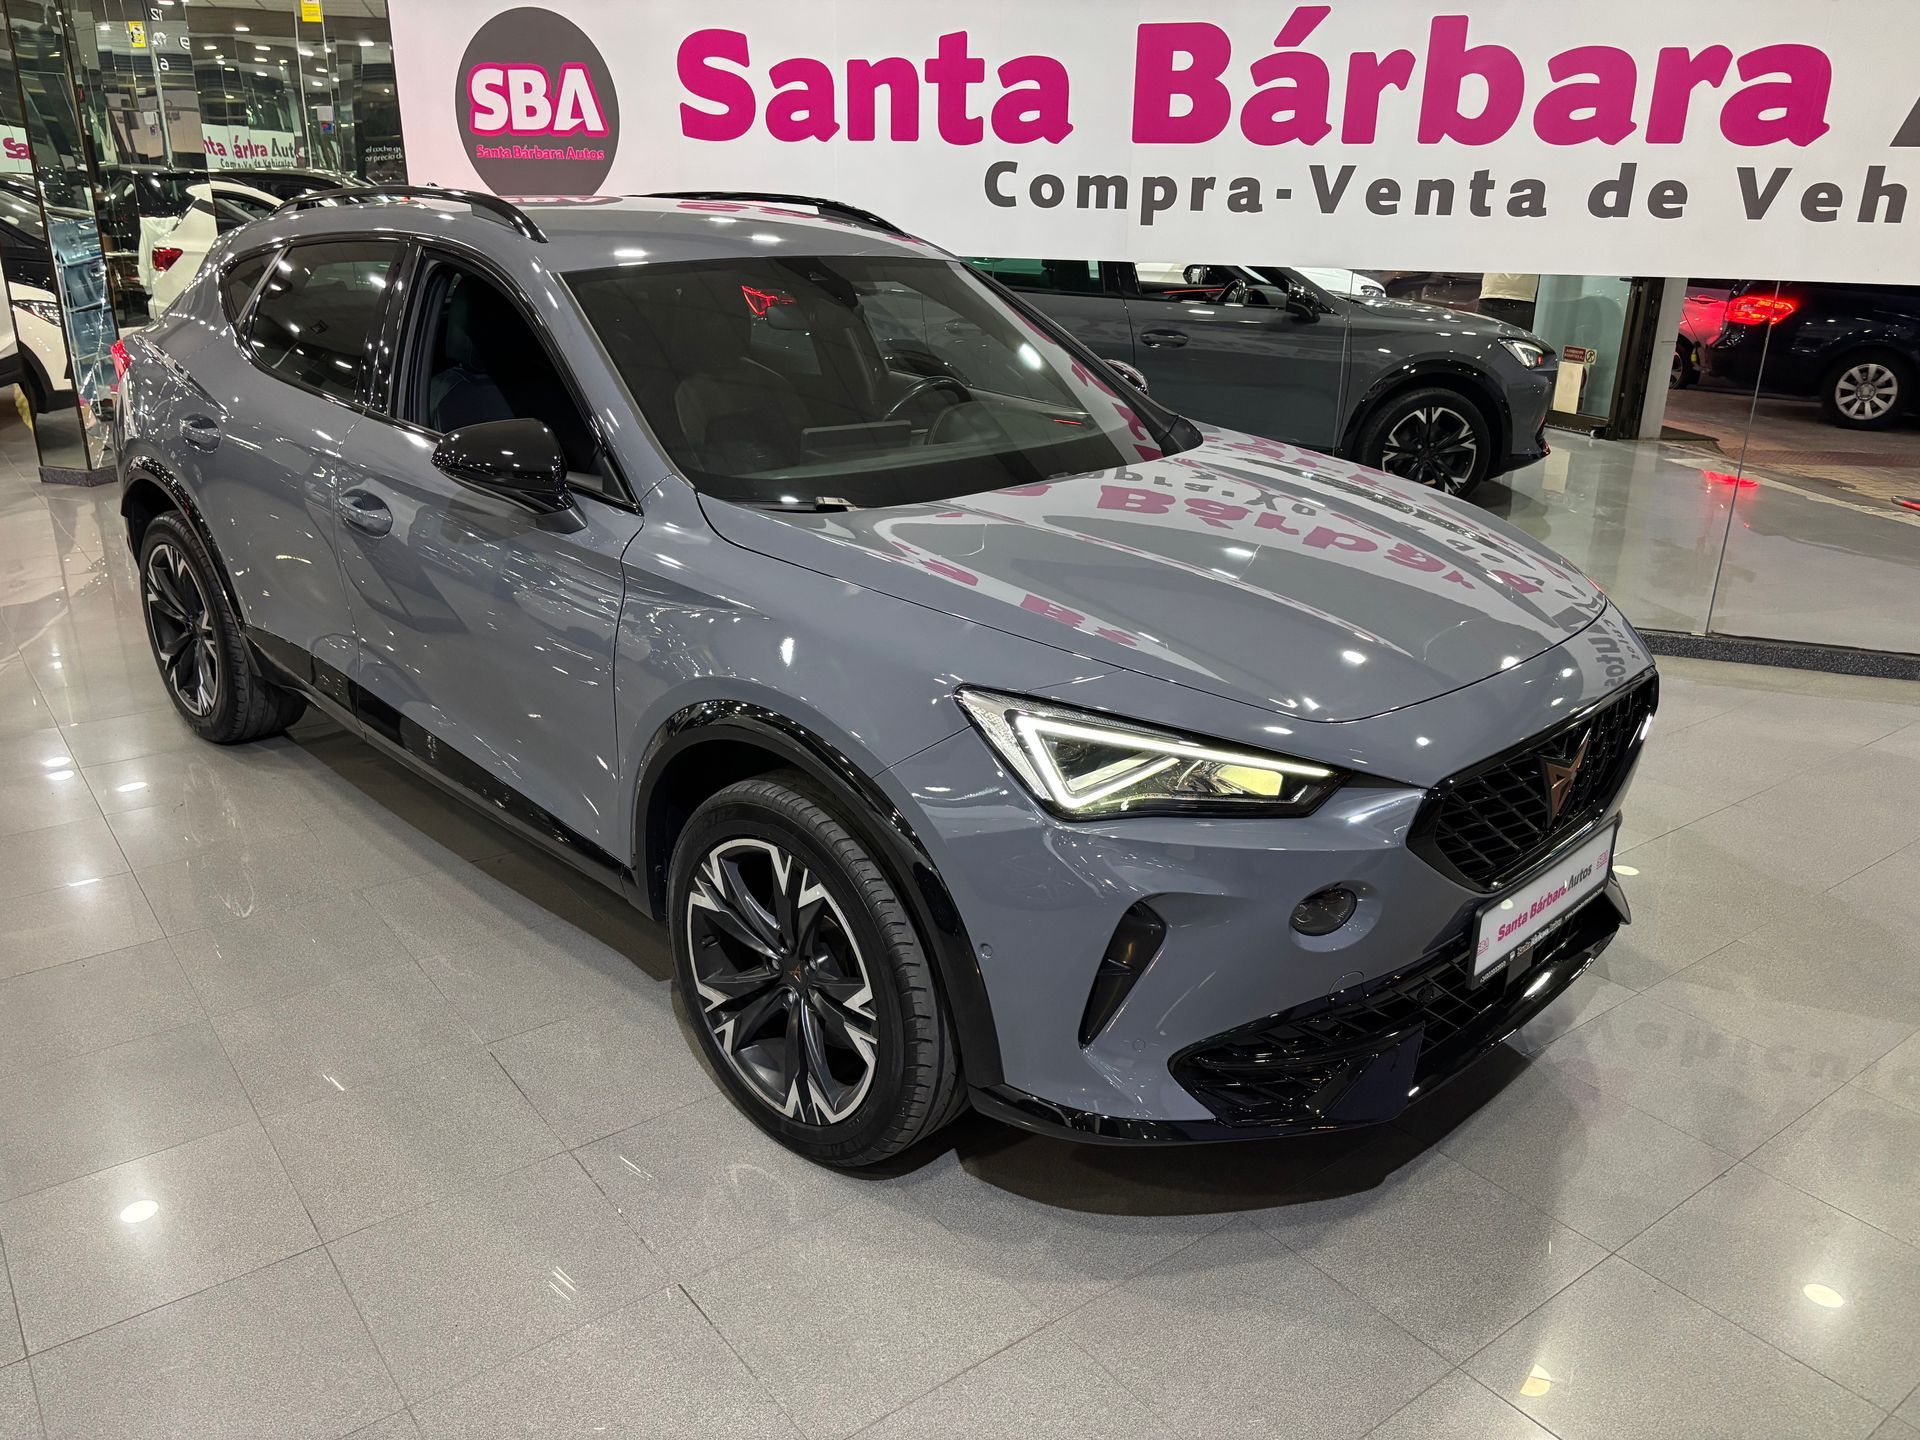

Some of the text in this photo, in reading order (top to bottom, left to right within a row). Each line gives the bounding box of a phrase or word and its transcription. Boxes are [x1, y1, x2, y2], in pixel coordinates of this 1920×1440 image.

[468, 63, 608, 137] SBA
[677, 29, 1073, 146] Santa
[1131, 6, 1831, 147] Bárbara
[475, 144, 605, 161] Santa Bárbara Autos
[985, 161, 1908, 226] Compra-Venta de Veh
[1497, 912, 1528, 941] Santa
[1529, 885, 1568, 920] Bárbara
[1567, 864, 1592, 890] Autos
